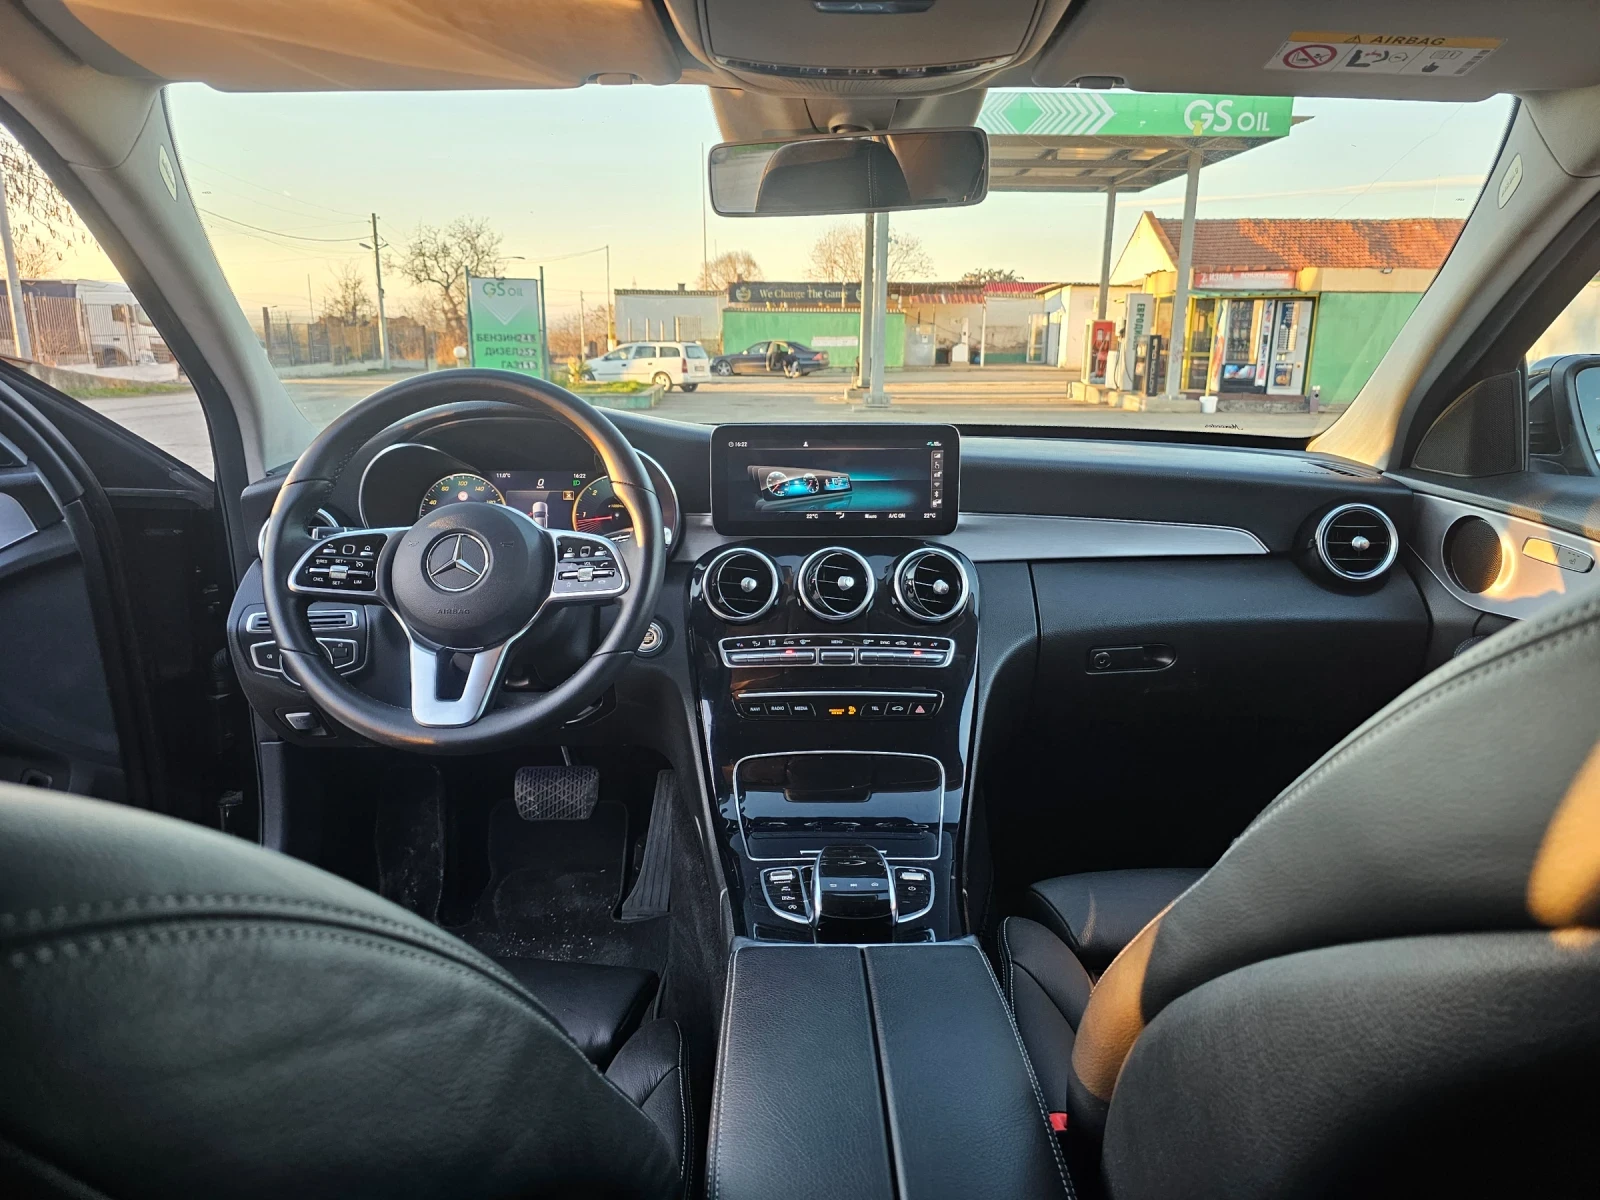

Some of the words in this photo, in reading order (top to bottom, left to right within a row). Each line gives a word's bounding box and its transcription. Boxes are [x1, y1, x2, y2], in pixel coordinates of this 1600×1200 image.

[1370, 35, 1445, 45] AIRBAG
[1184, 100, 1234, 132] GS
[1237, 112, 1270, 131] OIL
[482, 282, 506, 297] GS
[759, 289, 773, 299] We
[774, 289, 805, 300] Change
[807, 289, 823, 299] The
[1132, 303, 1146, 350] ЕВРОДИ
[476, 333, 517, 342] БЕНЗИН
[484, 347, 518, 356] ДИЗЕЛ
[501, 360, 518, 369] ГАЗ
[537, 478, 545, 486] 0
